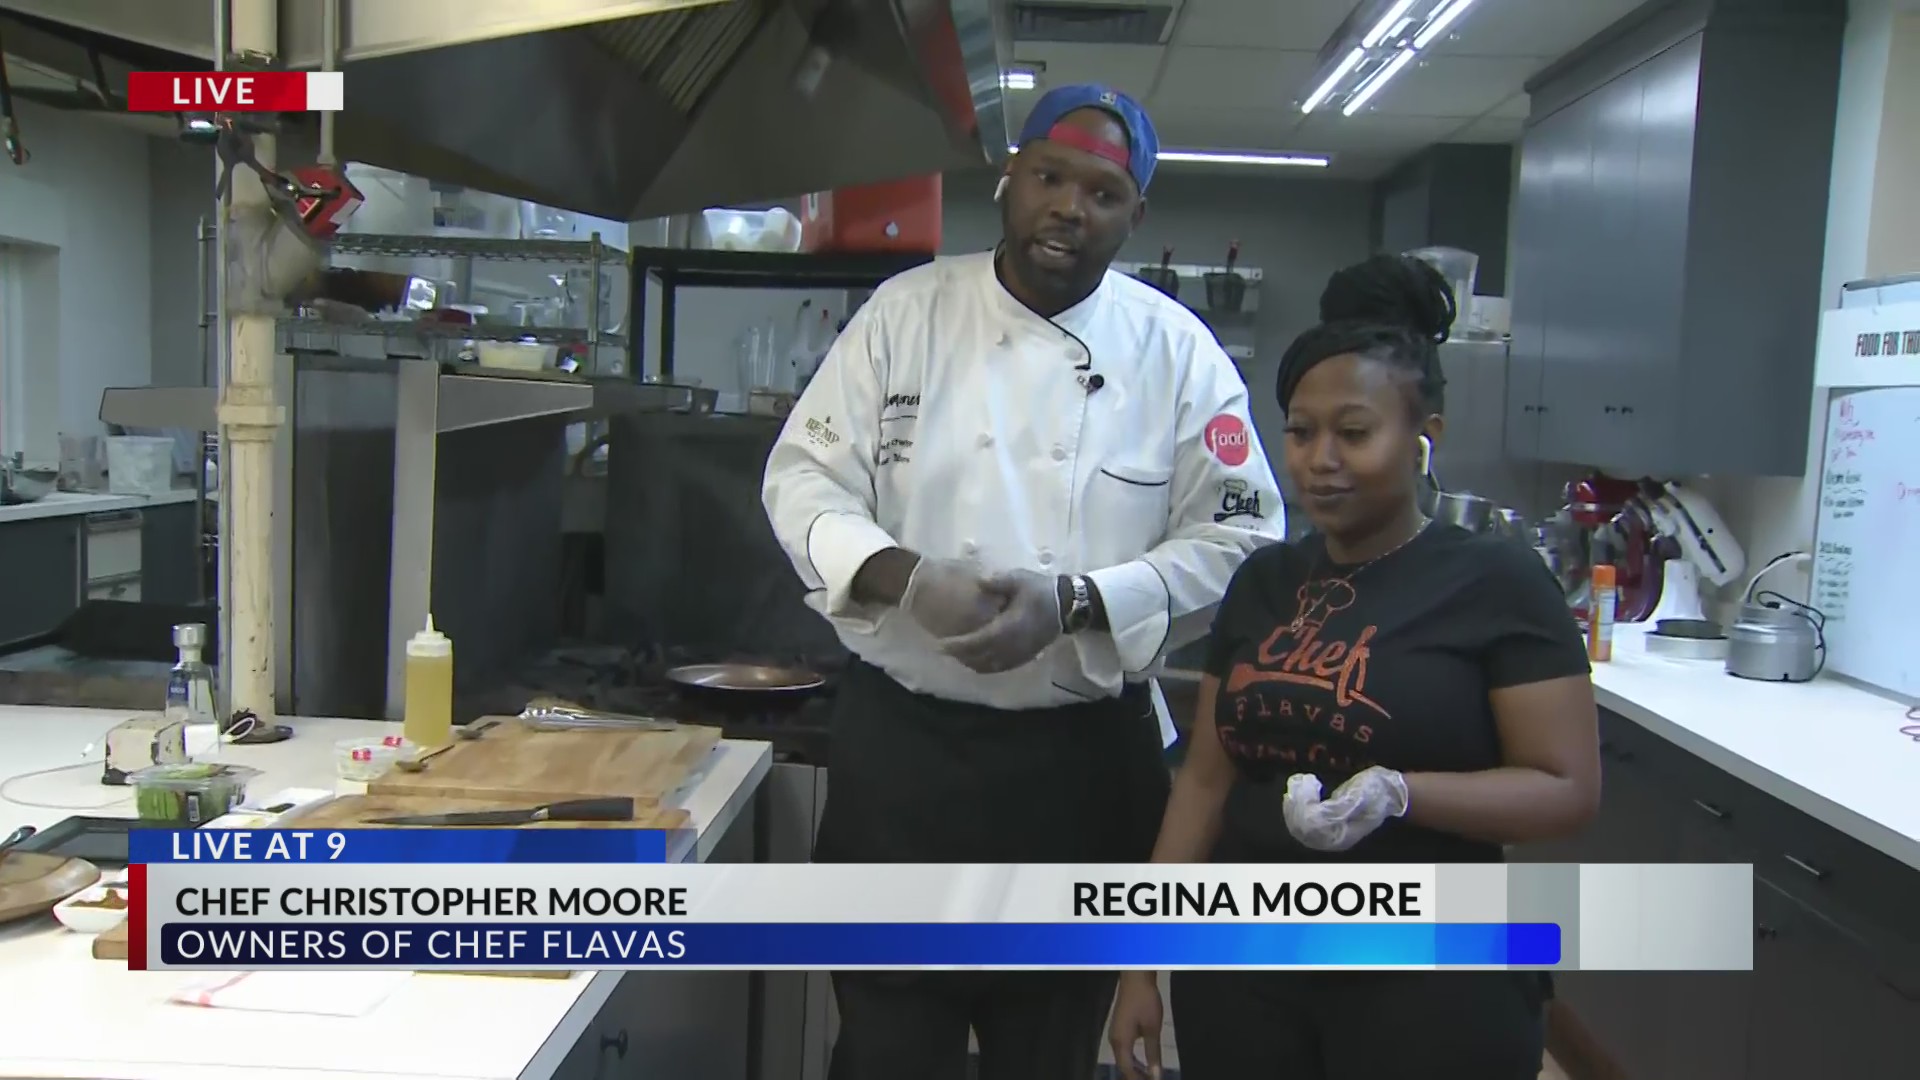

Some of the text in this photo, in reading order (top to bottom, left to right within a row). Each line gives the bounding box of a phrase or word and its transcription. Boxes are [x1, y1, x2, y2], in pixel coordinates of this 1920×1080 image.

[1855, 333, 1881, 357] FOOD
[1881, 331, 1900, 356] FOR
[1210, 426, 1248, 457] food
[1258, 625, 1378, 708] Chef
